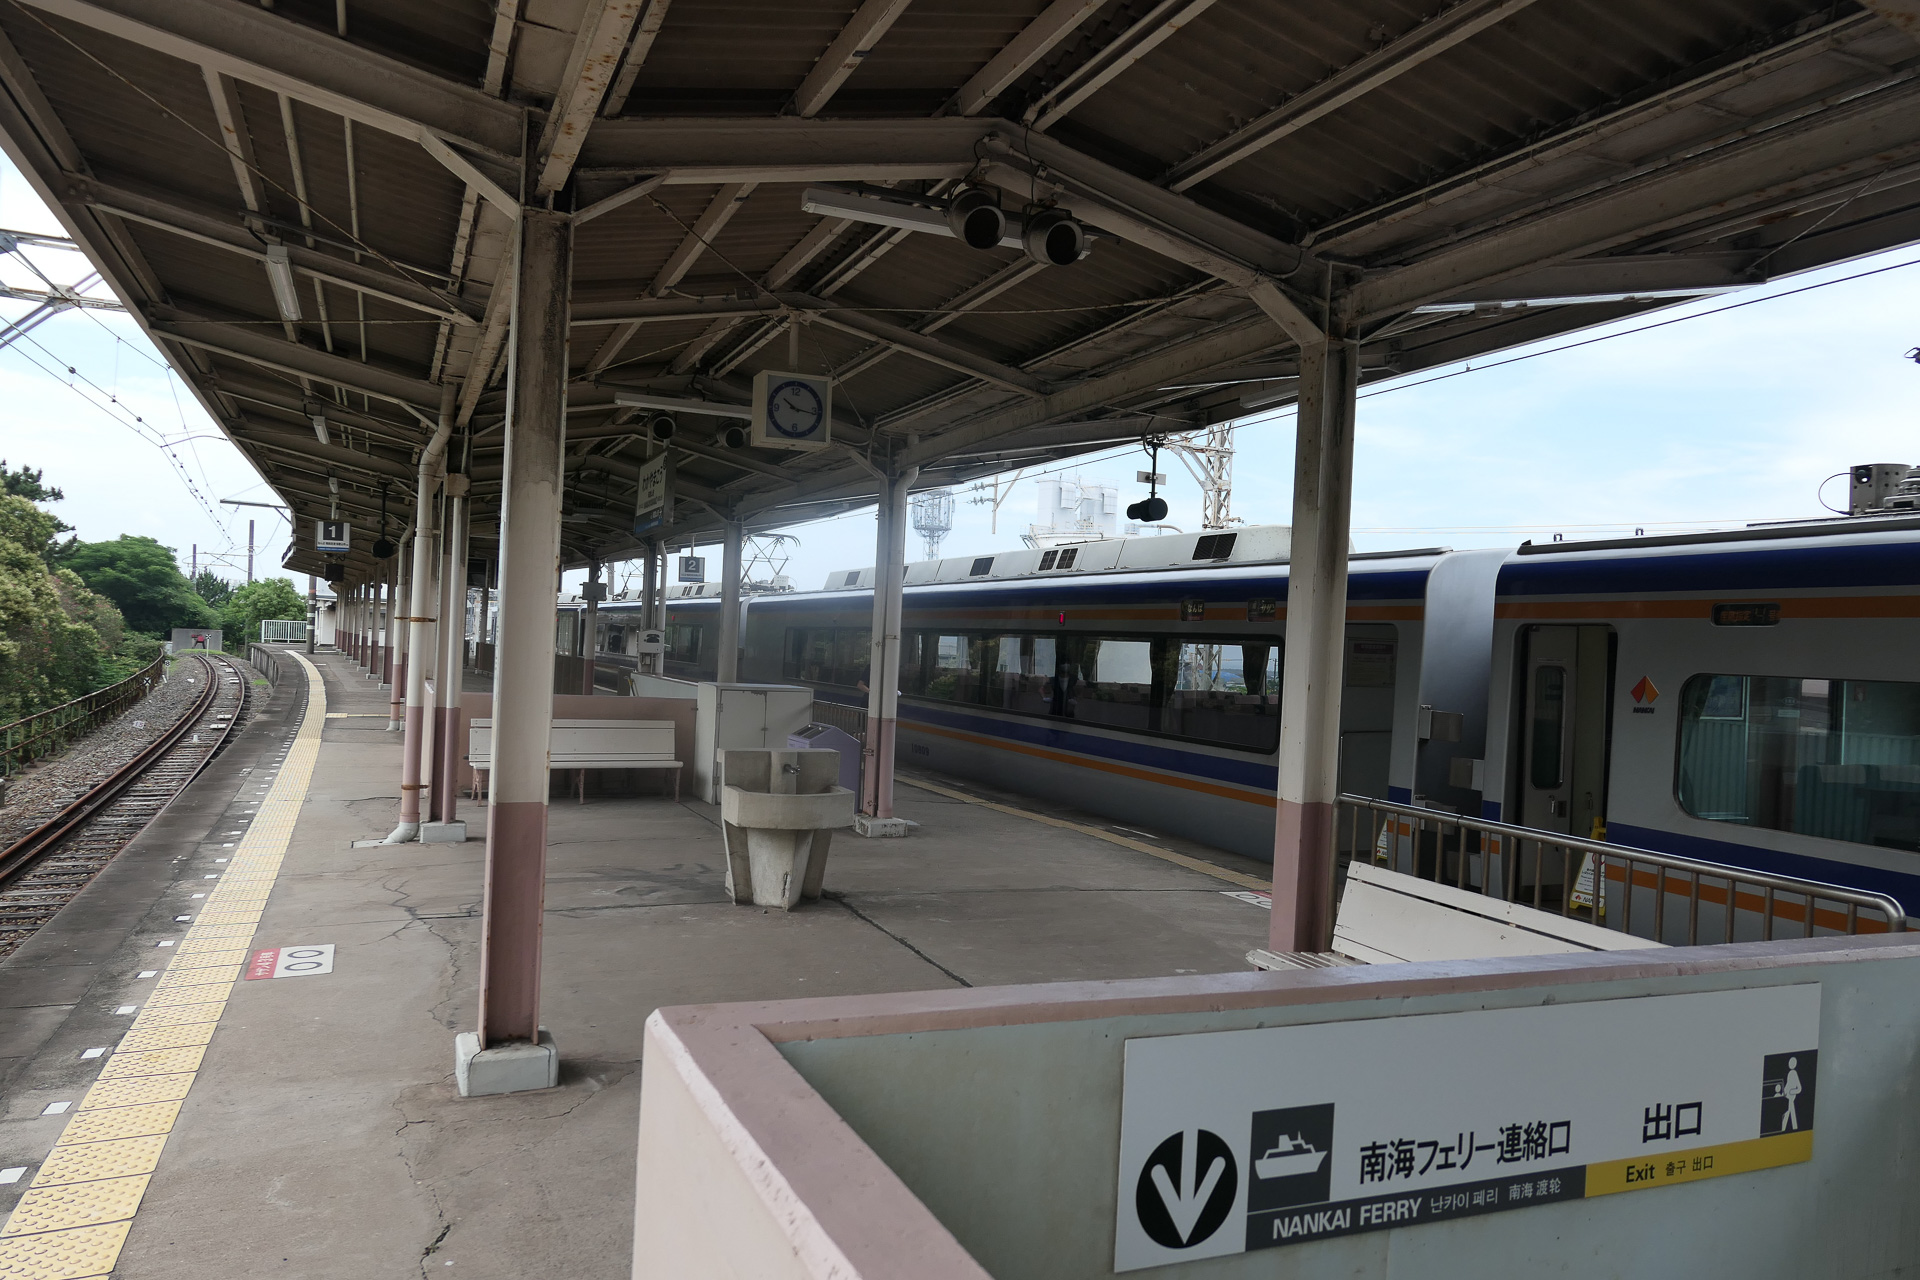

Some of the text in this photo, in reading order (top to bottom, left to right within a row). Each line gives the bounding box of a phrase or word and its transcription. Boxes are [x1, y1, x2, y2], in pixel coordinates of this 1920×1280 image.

[790, 387, 801, 397] 12
[773, 403, 780, 412] 9
[811, 406, 817, 415] 3
[791, 423, 798, 432] 6
[328, 525, 336, 538] 1
[688, 560, 696, 571] 2
[1642, 1101, 1702, 1143] 出口
[1359, 1120, 1571, 1184] 南海フェリー連絡口
[1665, 1160, 1687, 1177] 출구
[1692, 1155, 1714, 1172] 出口
[1625, 1163, 1656, 1183] Exit
[1508, 1177, 1562, 1201] 南海 渡轮
[1430, 1187, 1499, 1214] 난카이 페리
[1272, 1197, 1422, 1239] NANKAI FERRY
